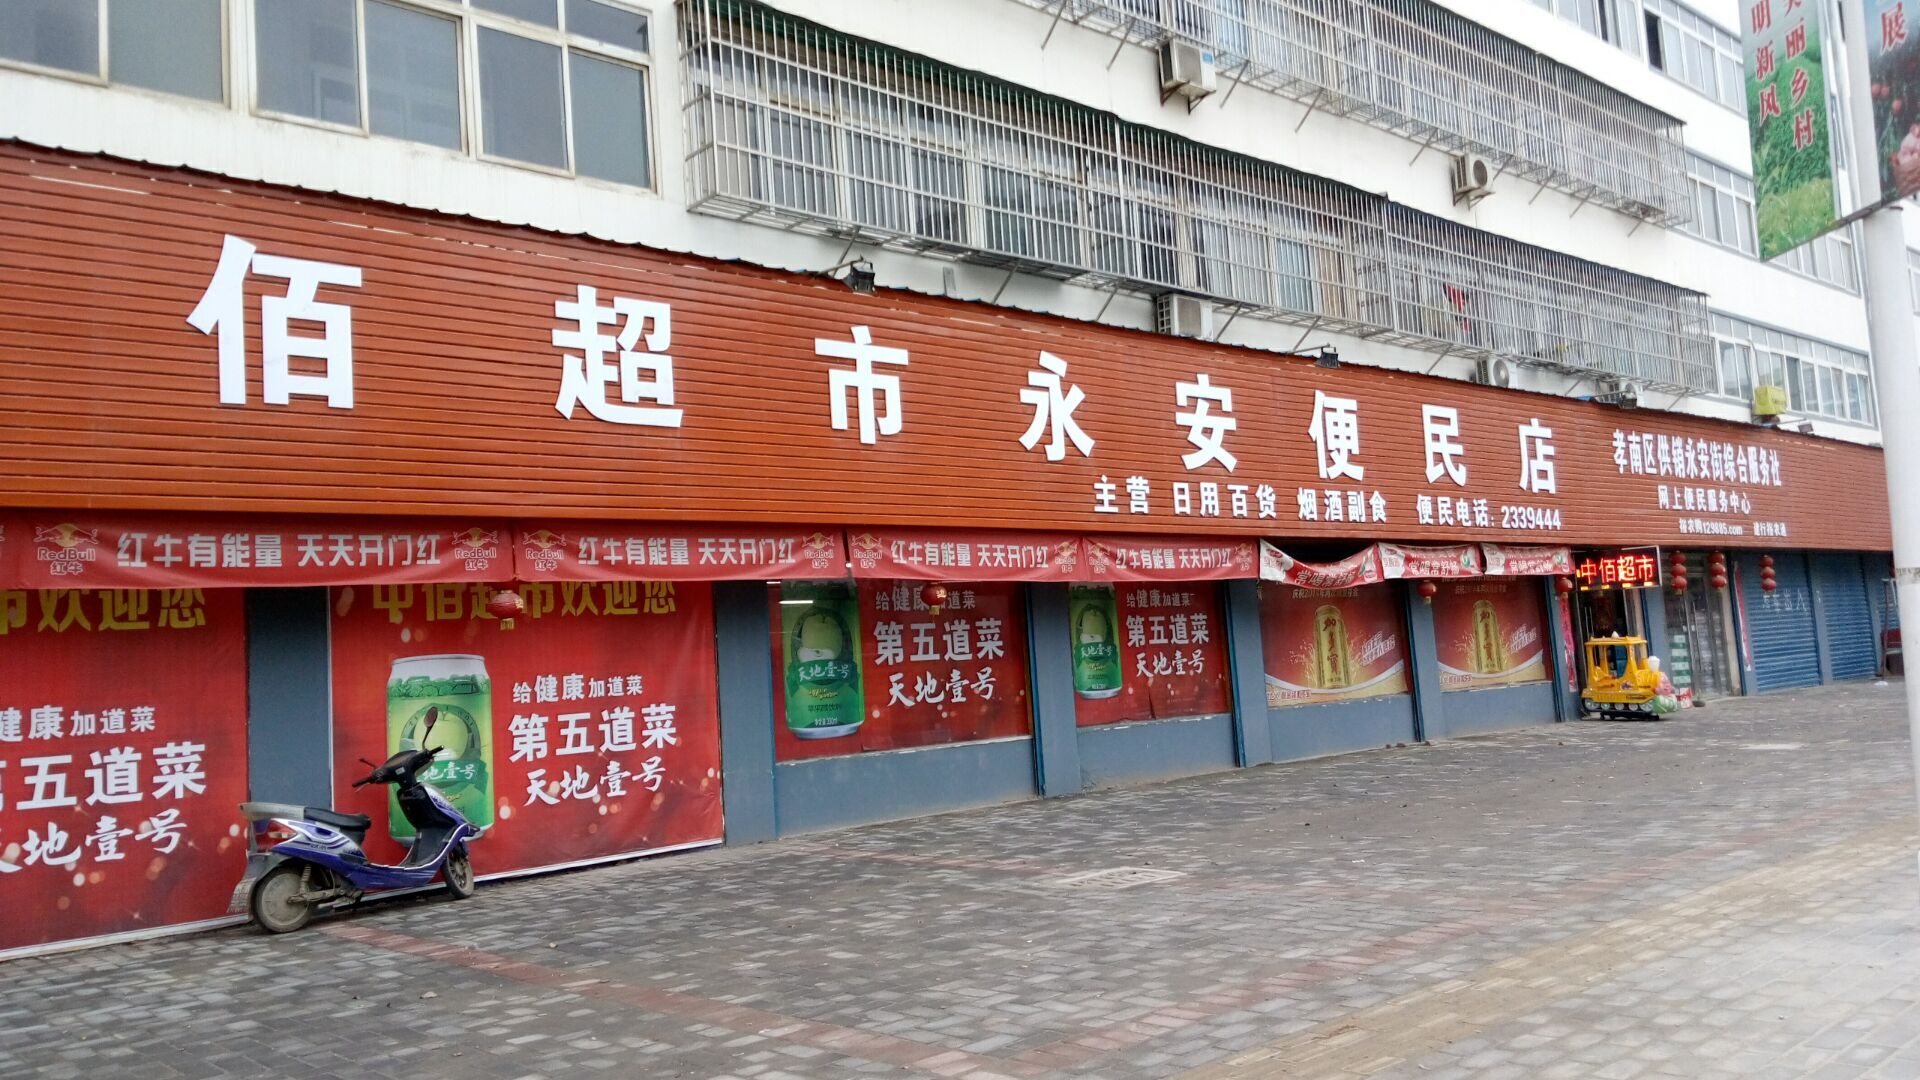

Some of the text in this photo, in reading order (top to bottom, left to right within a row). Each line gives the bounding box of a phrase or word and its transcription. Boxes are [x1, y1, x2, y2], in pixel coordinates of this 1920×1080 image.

[186, 234, 1557, 494] 佰超市永安便民店
[1612, 428, 1782, 486] 孝南区供销永安街综合服务社
[1093, 474, 1151, 514] 主营
[1172, 481, 1277, 519] 日用百货
[1297, 487, 1387, 523] 烟酒副食
[1657, 484, 1751, 515] 网上便民服务中心
[117, 533, 441, 568] 红牛有能量 天天开门红
[465, 560, 489, 571] 红牛
[577, 536, 796, 566] 红牛有能量 天天开门红
[891, 540, 1049, 568] 红牛有能量 天天开门红
[1115, 547, 1232, 569] 红牛有能量 天天开门红
[50, 561, 83, 576] 红牛
[1580, 554, 1654, 584] 中佰超市
[1126, 588, 1191, 608] 给健康加道菜
[873, 618, 1004, 665] 第五道菜
[1126, 613, 1209, 648] 第五道菜
[798, 661, 850, 682] 天地壹号
[1136, 649, 1205, 678] 天地壹号
[513, 673, 643, 704] 给健康加道菜
[887, 666, 996, 707] 天地壹号
[508, 703, 678, 763] 第五道菜
[0, 741, 206, 812] 五道菜
[423, 761, 476, 780] 地壹号
[524, 756, 667, 807] 天地壹号
[0, 808, 187, 873] 地壹号
